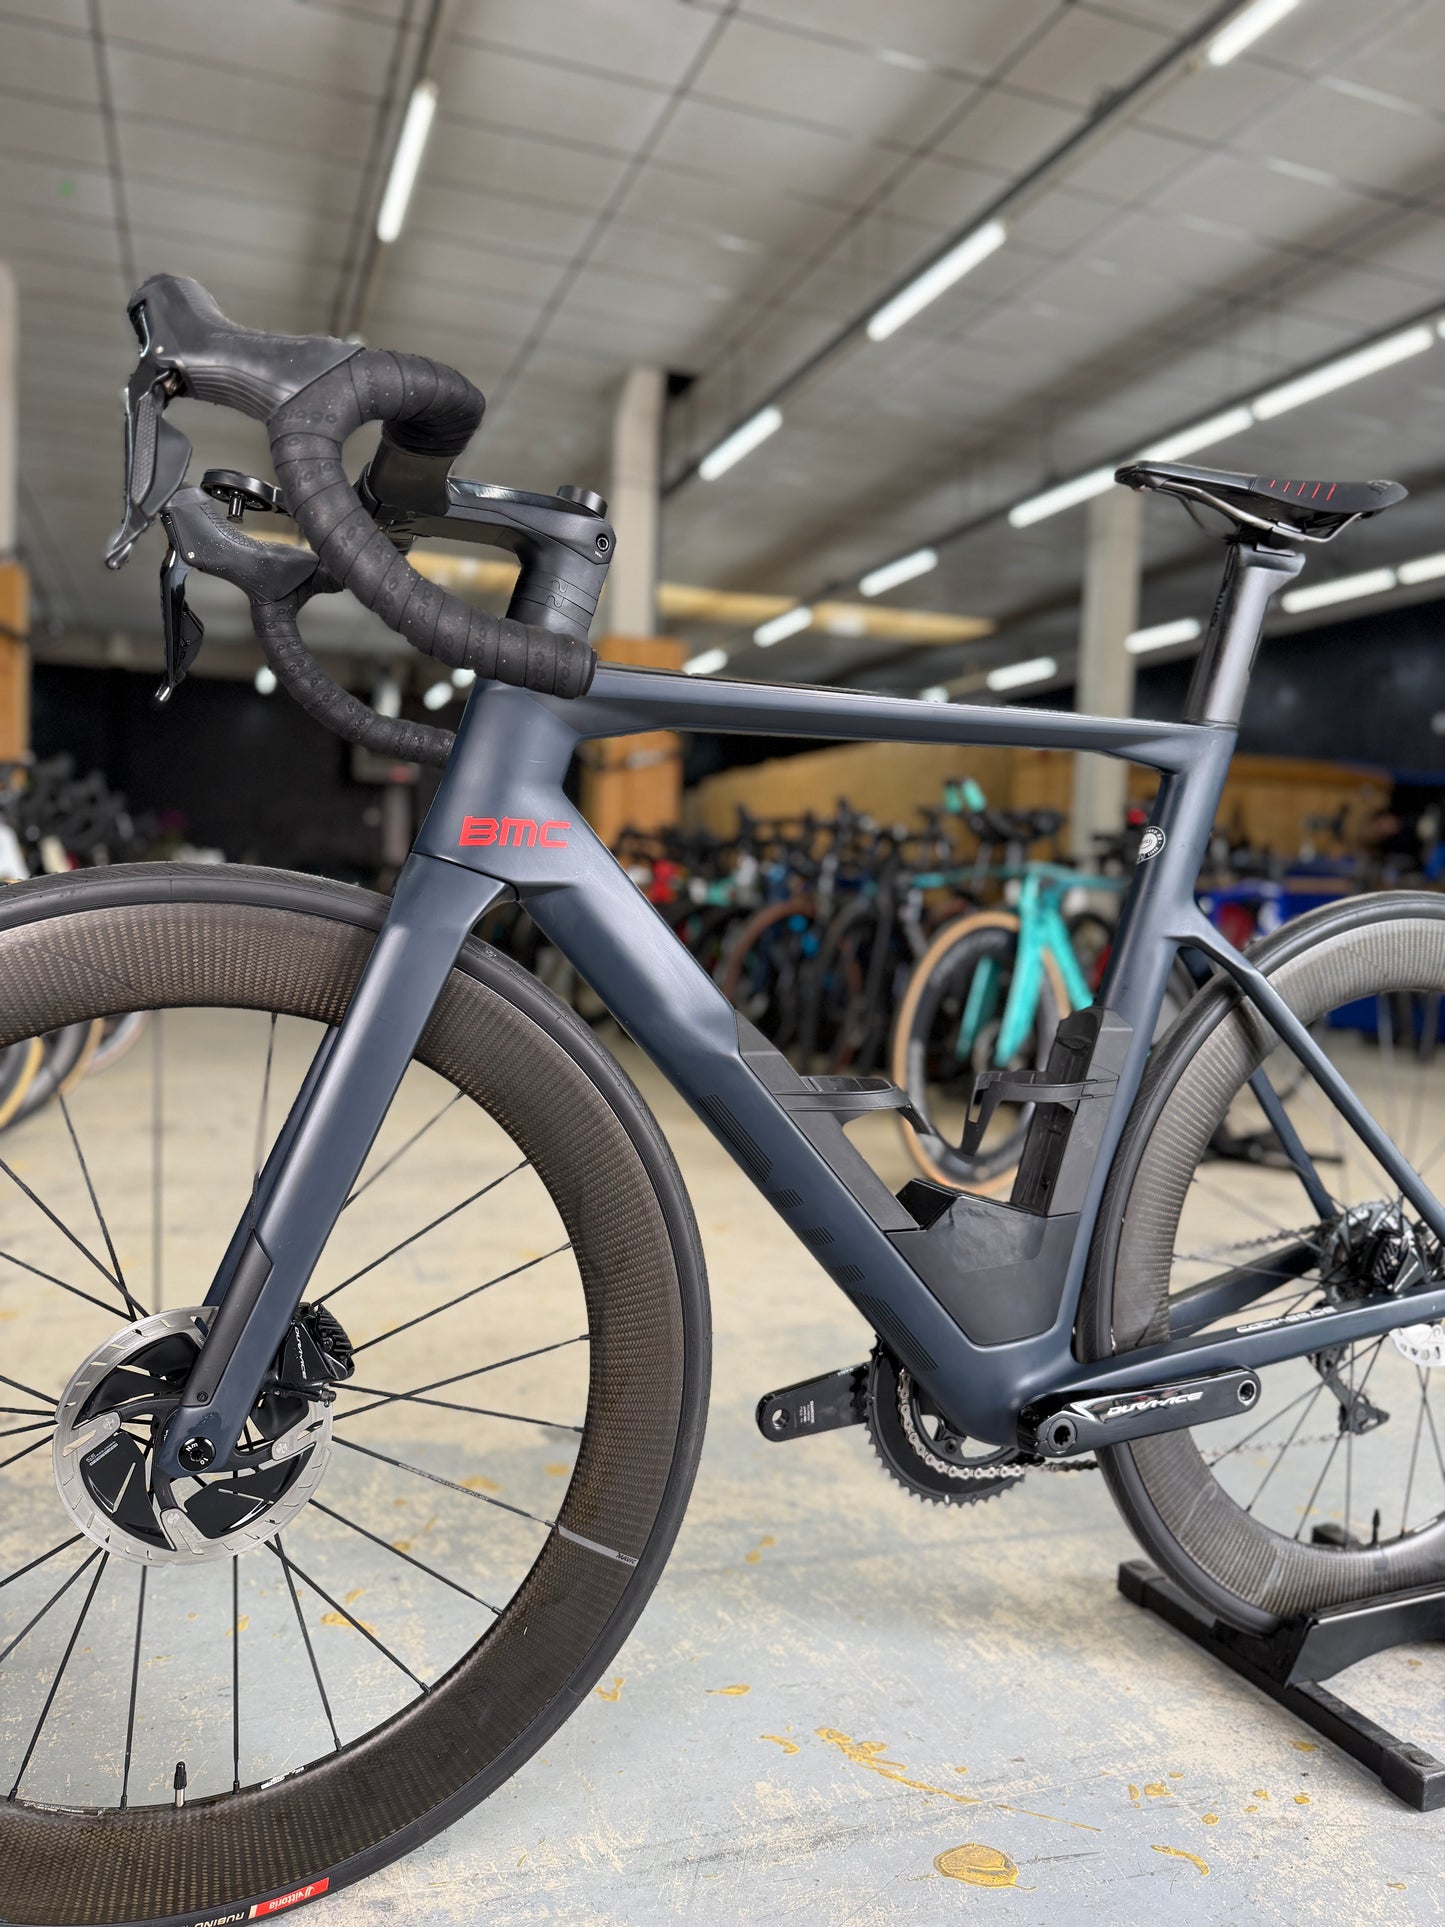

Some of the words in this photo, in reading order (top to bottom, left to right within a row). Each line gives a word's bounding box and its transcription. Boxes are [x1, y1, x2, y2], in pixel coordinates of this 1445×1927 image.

[458, 816, 571, 849] BMC
[1106, 1391, 1204, 1416] DURA-ACE
[269, 1891, 304, 1910] vittoria
